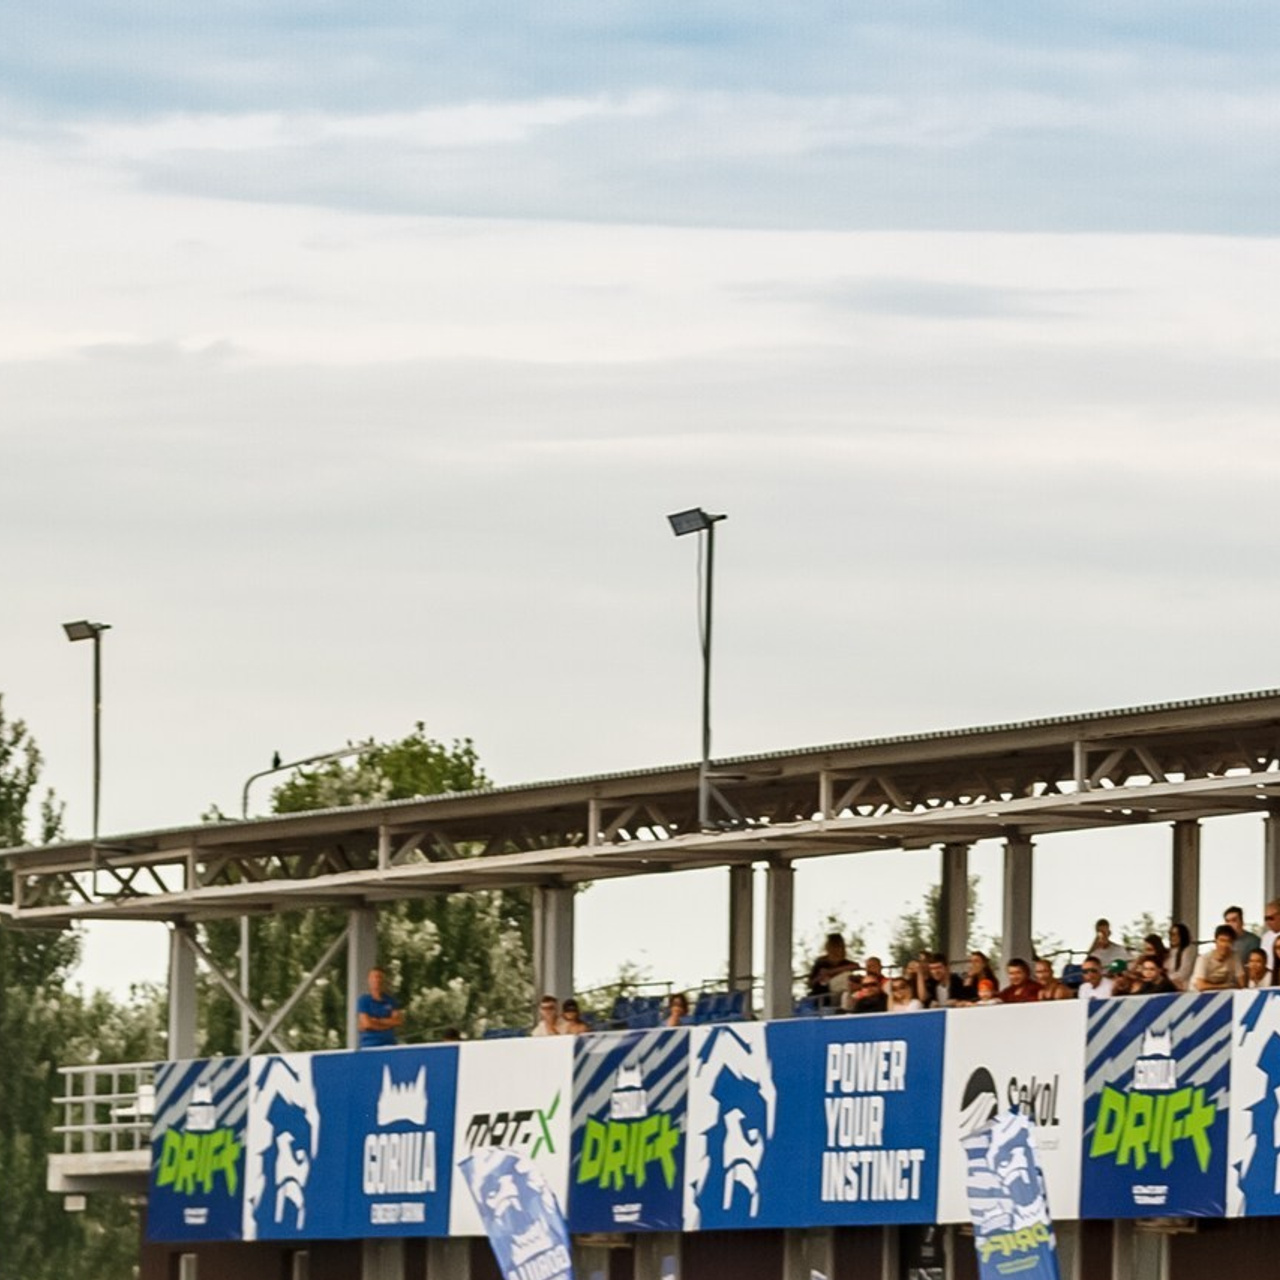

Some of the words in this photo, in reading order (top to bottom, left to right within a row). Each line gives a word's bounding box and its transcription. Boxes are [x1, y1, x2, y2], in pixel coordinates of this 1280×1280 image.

[825, 1040, 907, 1093] POWER
[576, 1114, 680, 1192] DRIFT
[824, 1096, 885, 1147] YOUR
[1089, 1086, 1217, 1173] DRIFT
[156, 1127, 242, 1197] DRIFT
[363, 1131, 436, 1194] GORILLA
[821, 1149, 926, 1202] INSTINCT
